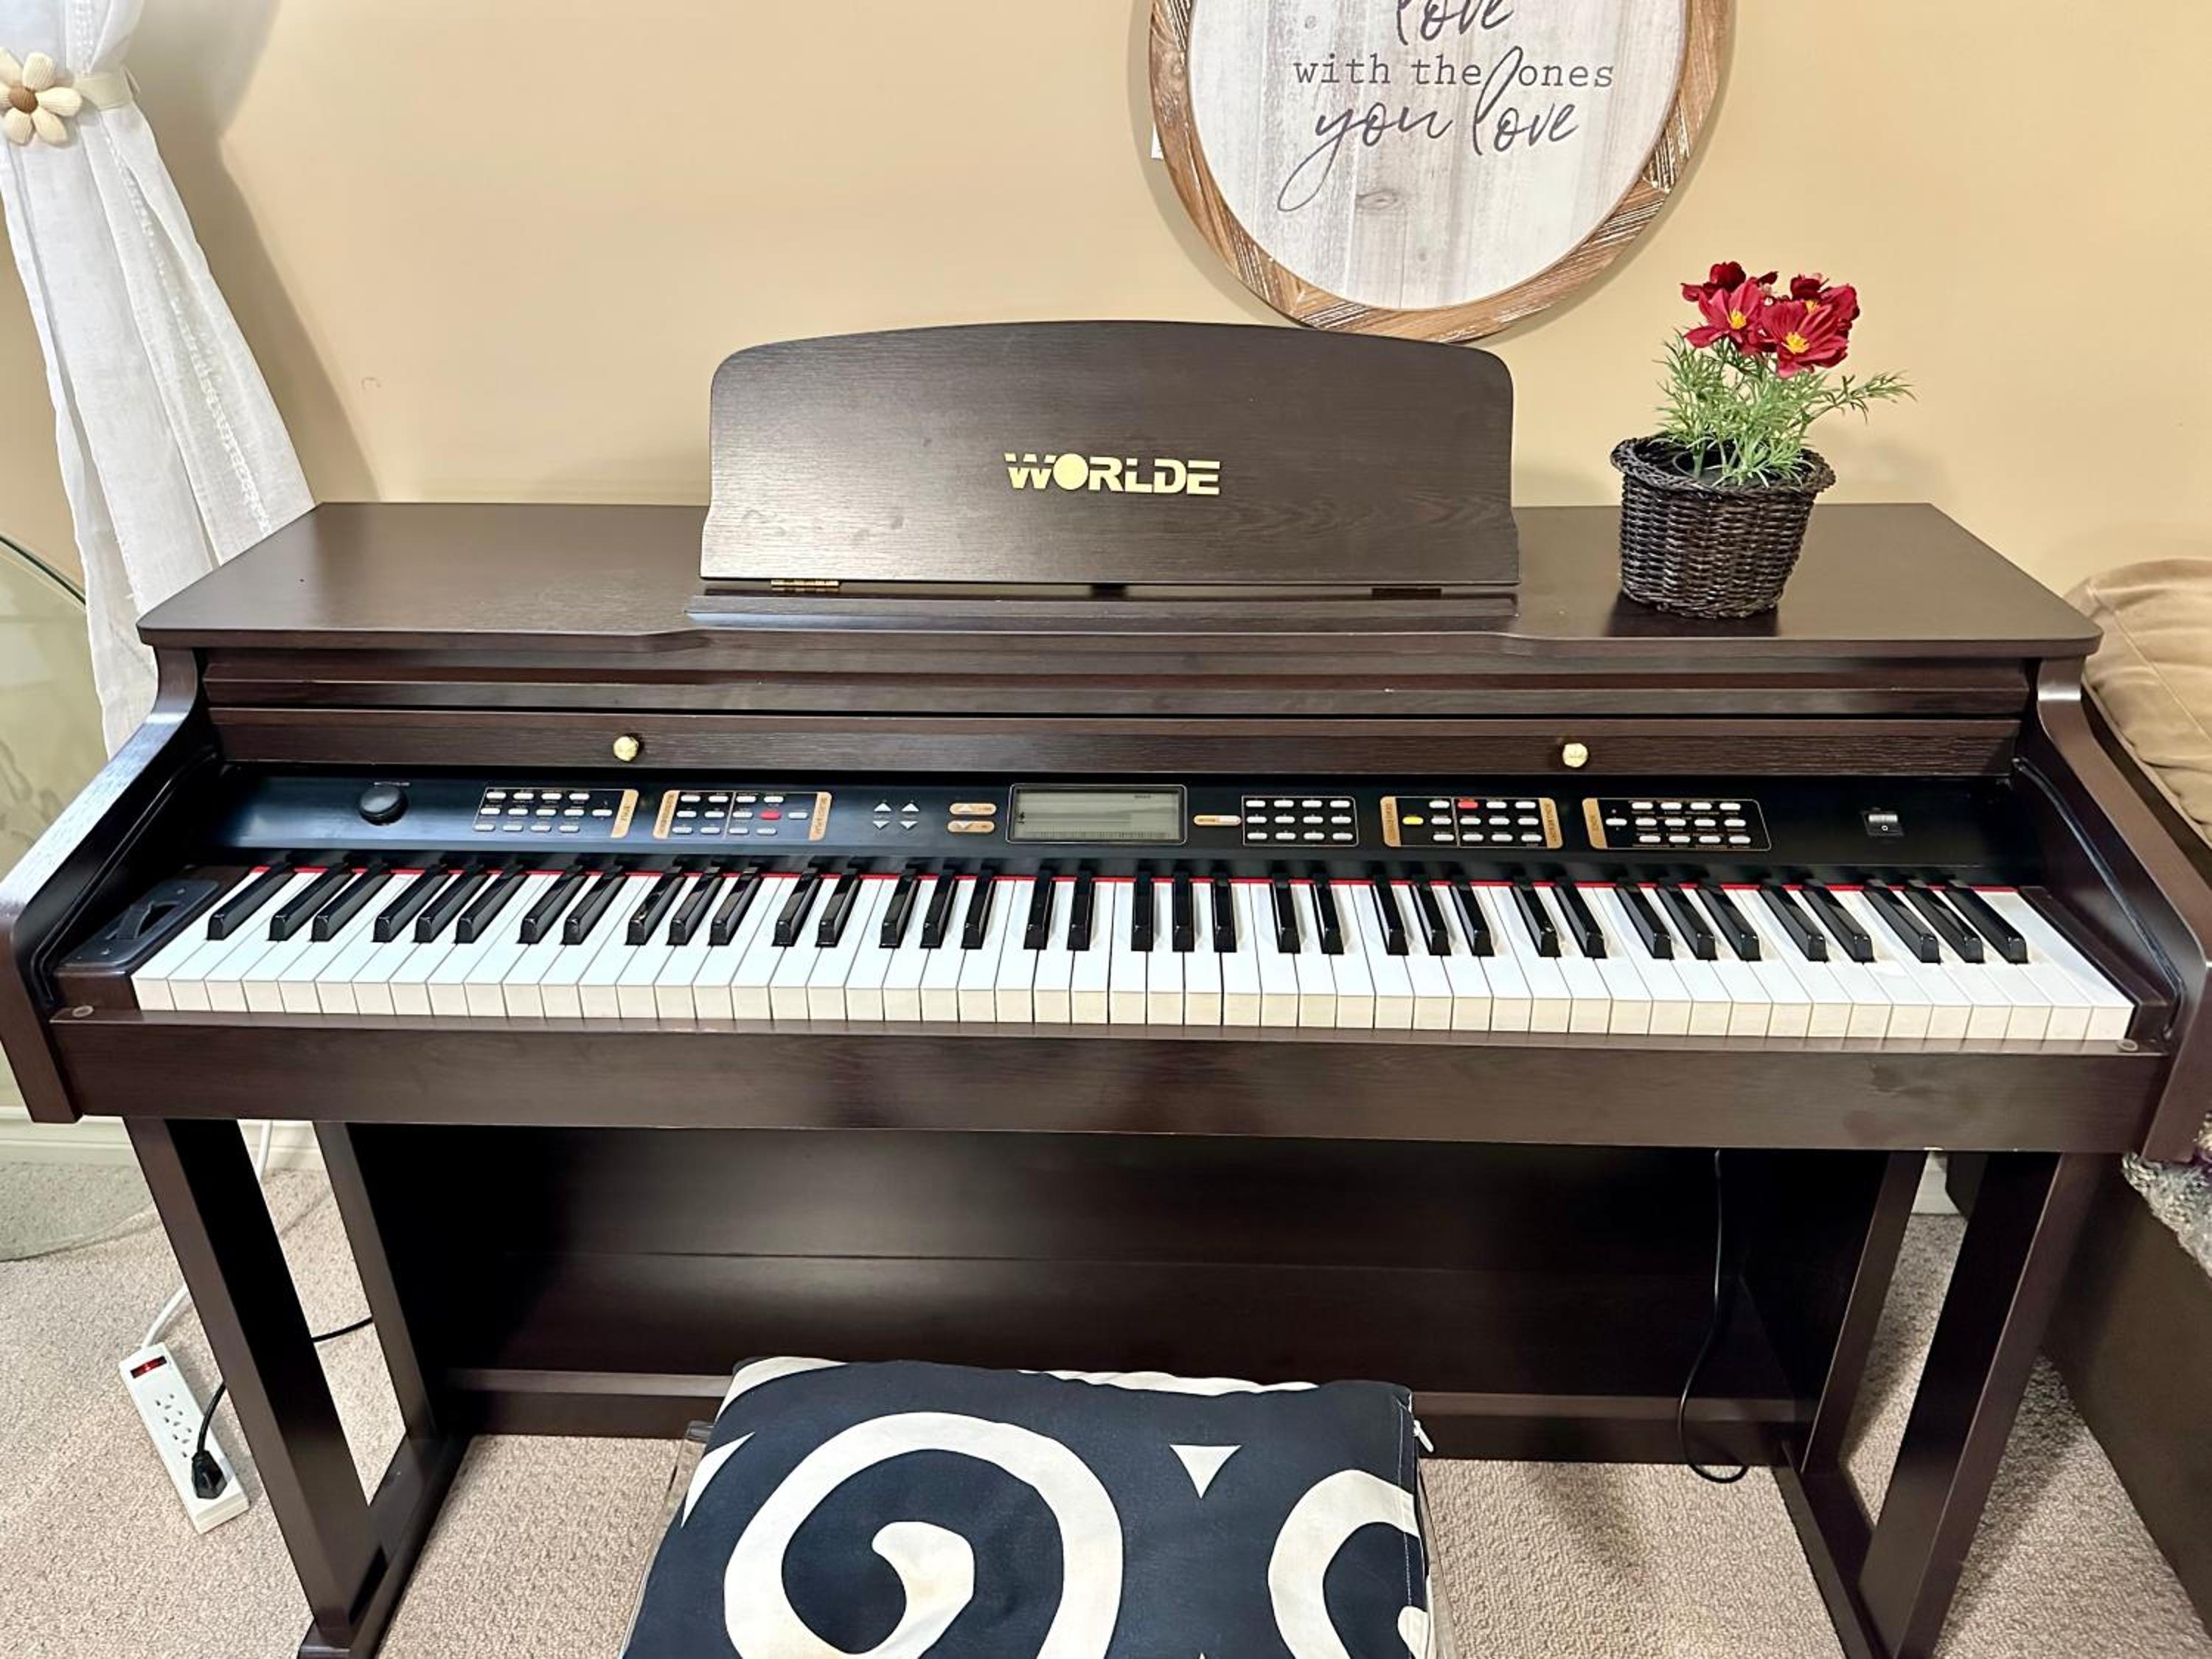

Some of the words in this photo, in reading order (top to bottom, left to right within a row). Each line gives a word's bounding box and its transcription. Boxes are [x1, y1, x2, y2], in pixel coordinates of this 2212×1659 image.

[1293, 52, 1391, 84] with
[1411, 54, 1482, 86] the
[1517, 64, 1615, 88] ones
[1276, 102, 1453, 212] you
[1472, 45, 1579, 156] love
[1004, 452, 1221, 495] WORLDE
